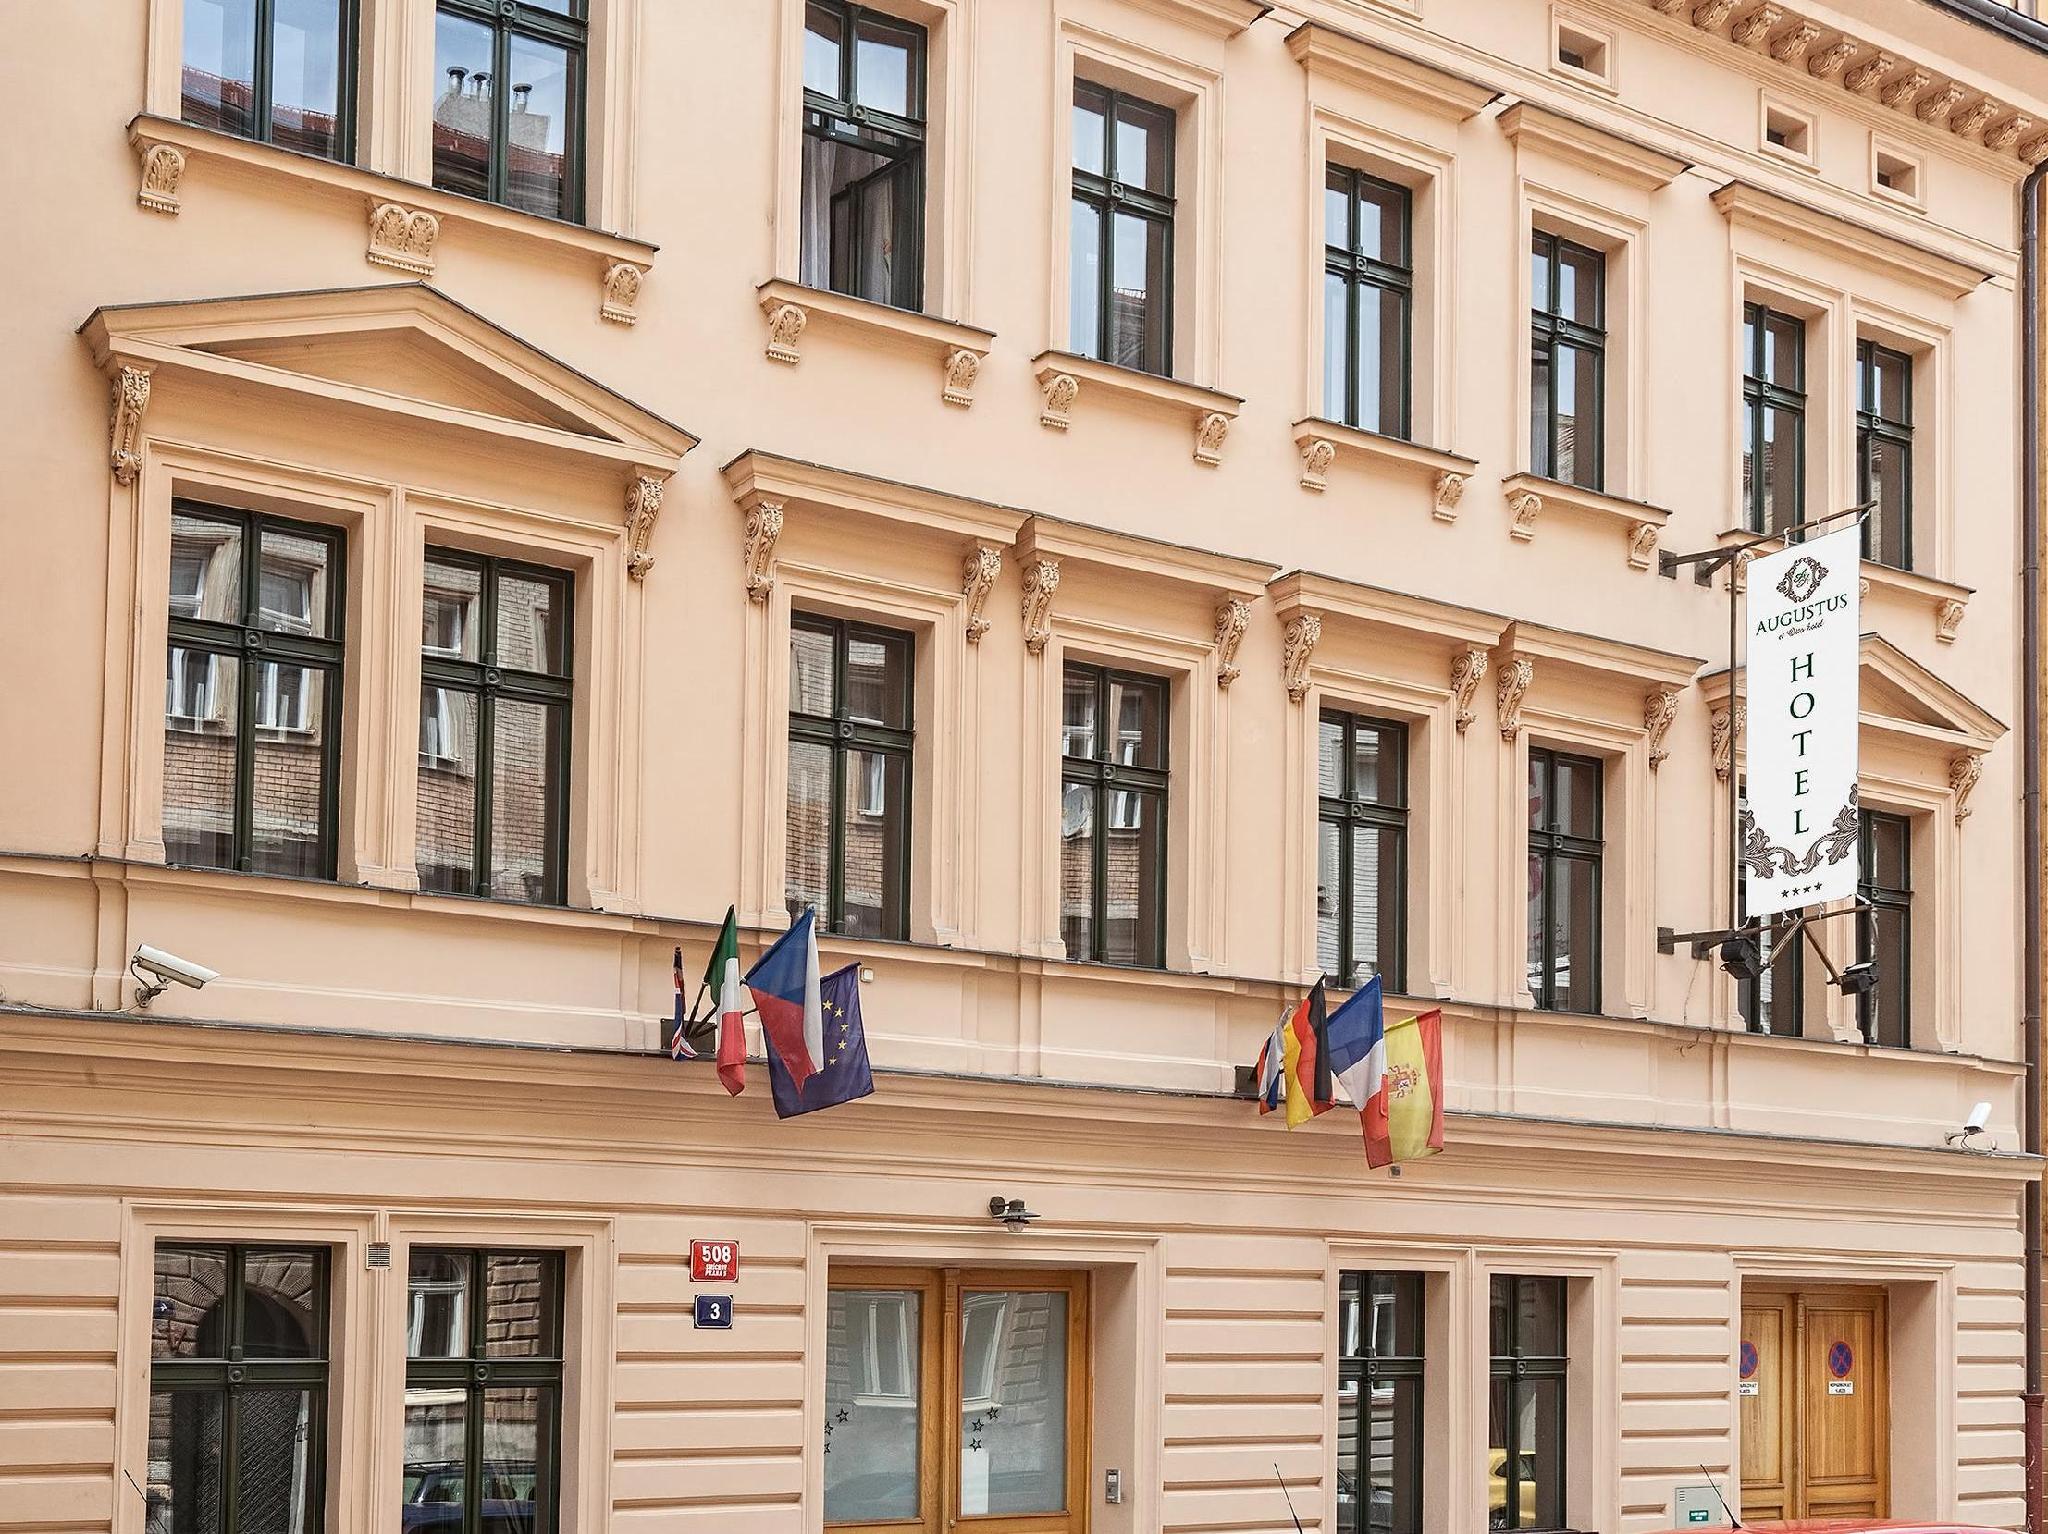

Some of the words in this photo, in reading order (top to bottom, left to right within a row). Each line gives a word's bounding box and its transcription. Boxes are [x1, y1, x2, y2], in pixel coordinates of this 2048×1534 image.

[1756, 594, 1847, 635] AUGUSTUS
[1790, 653, 1815, 834] HOTEL
[702, 1246, 731, 1263] 508
[710, 1303, 720, 1320] 3
